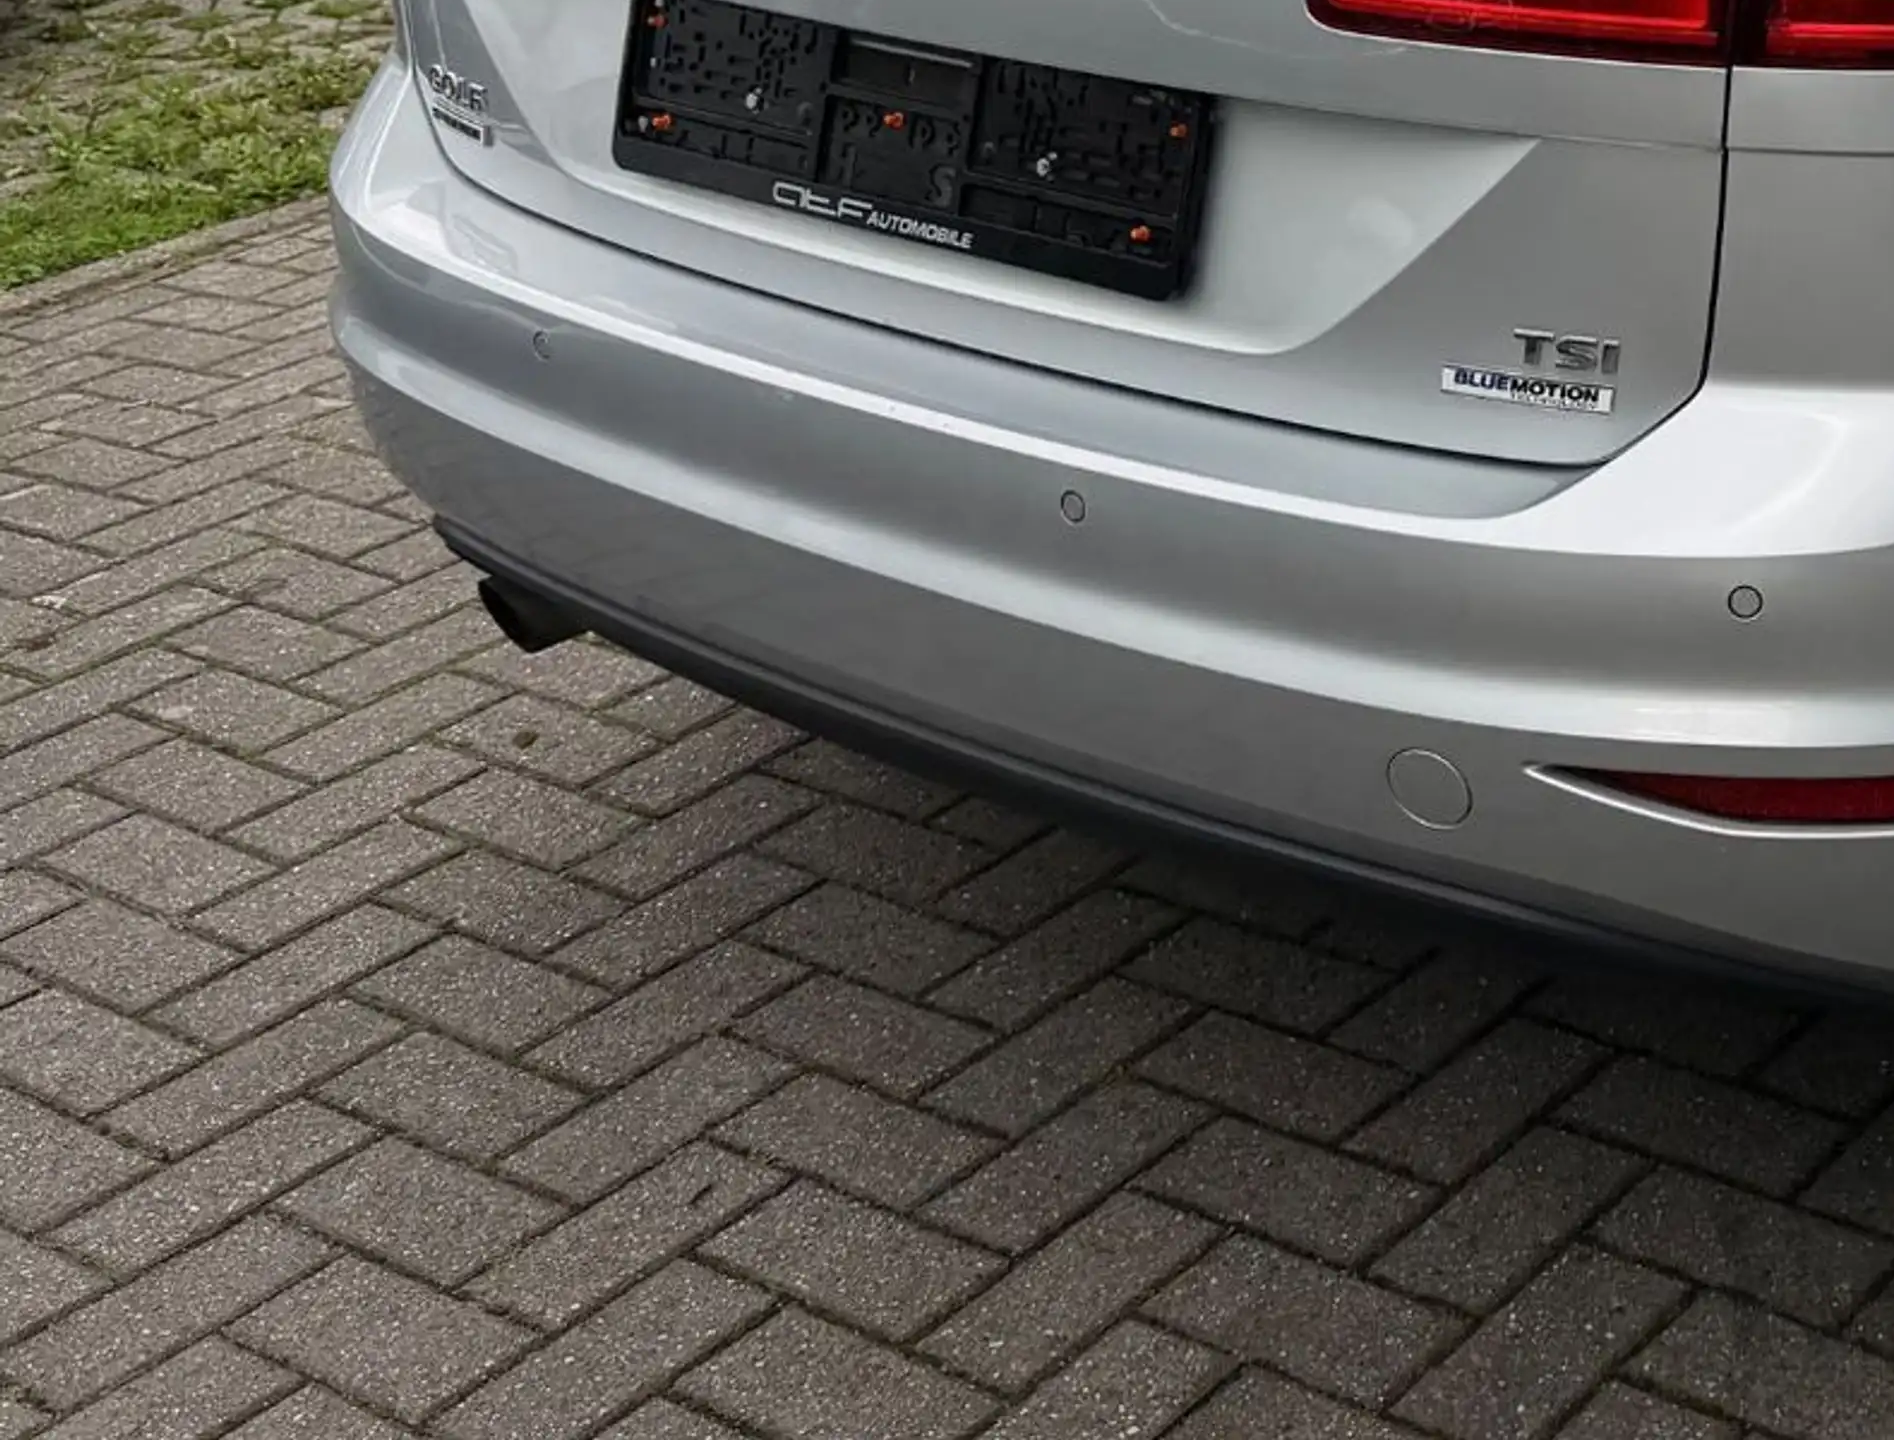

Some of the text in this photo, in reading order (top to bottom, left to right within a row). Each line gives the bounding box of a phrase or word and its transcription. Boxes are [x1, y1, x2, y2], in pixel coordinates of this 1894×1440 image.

[866, 210, 974, 249] AUTOMOBILE
[1513, 327, 1621, 375] TSI
[1453, 367, 1600, 402] BLUEMOTION
